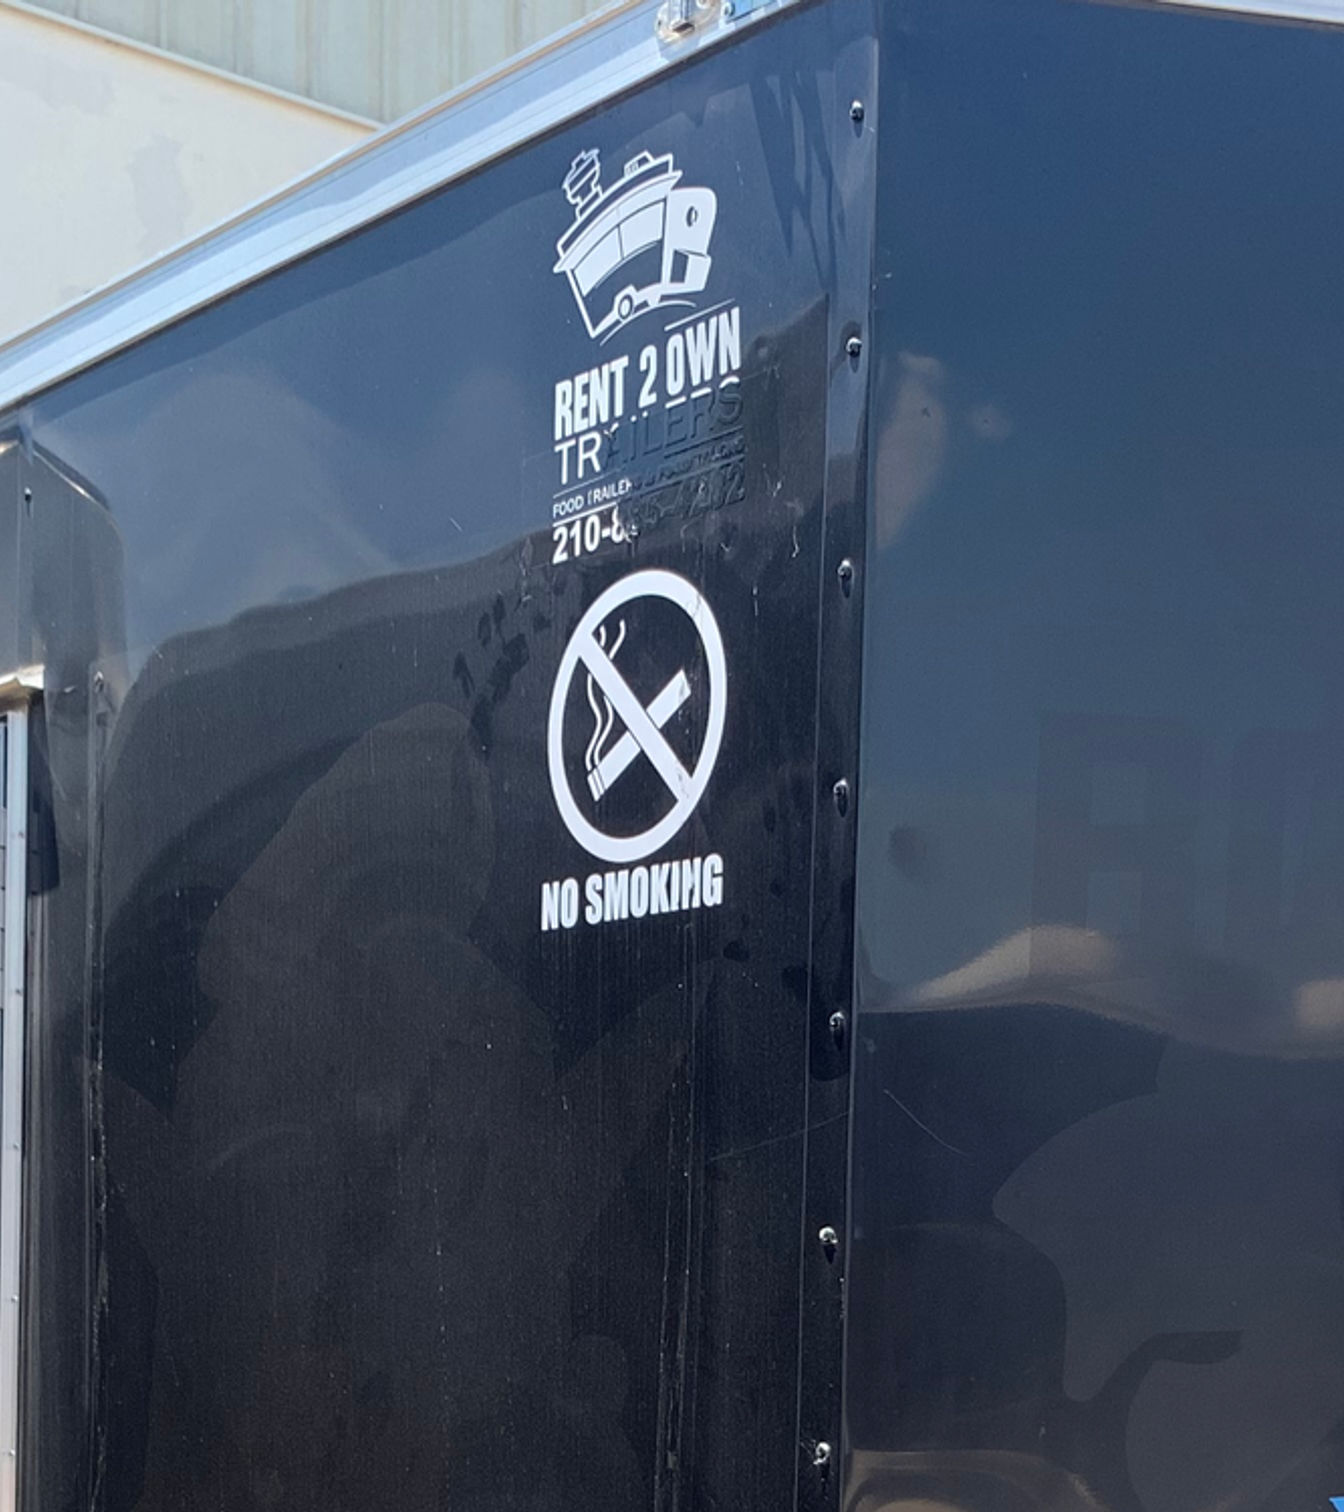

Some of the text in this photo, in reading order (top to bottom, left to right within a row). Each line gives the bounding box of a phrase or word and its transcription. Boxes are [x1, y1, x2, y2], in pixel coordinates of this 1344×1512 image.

[554, 306, 741, 441] RENT 2 OWN
[553, 495, 584, 519] FOOD
[541, 853, 723, 931] NO SMOKING
